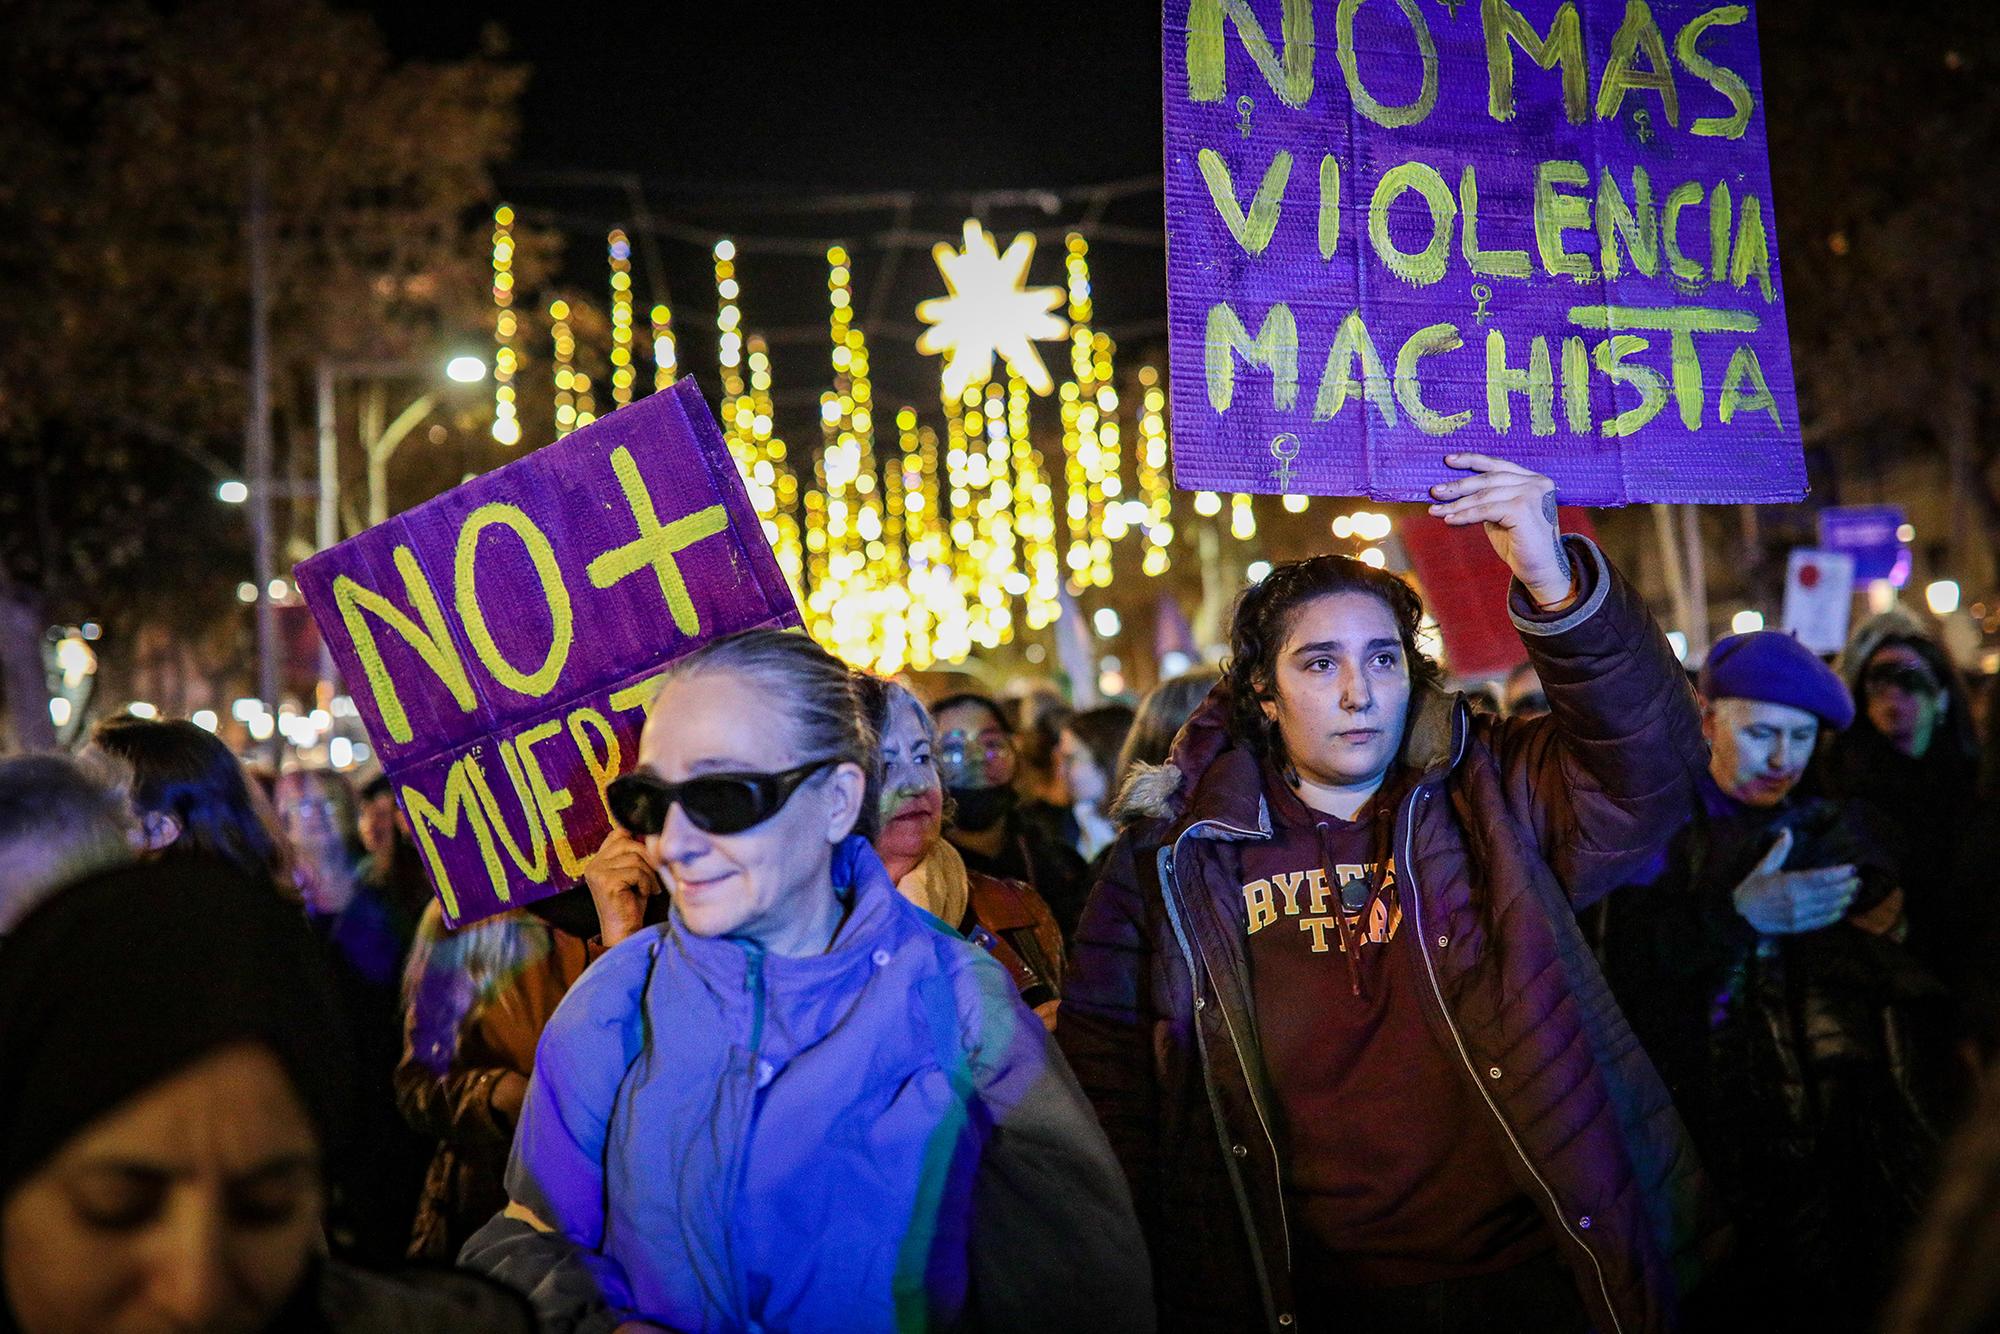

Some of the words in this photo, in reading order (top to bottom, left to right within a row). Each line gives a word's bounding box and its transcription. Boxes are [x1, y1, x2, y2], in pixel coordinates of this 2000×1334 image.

[1185, 0, 1439, 129] NO
[1480, 0, 1756, 140] MAS
[1198, 147, 1779, 304] VIOLENCIA
[1205, 302, 1784, 438] MACHISTA
[333, 502, 573, 744] NO
